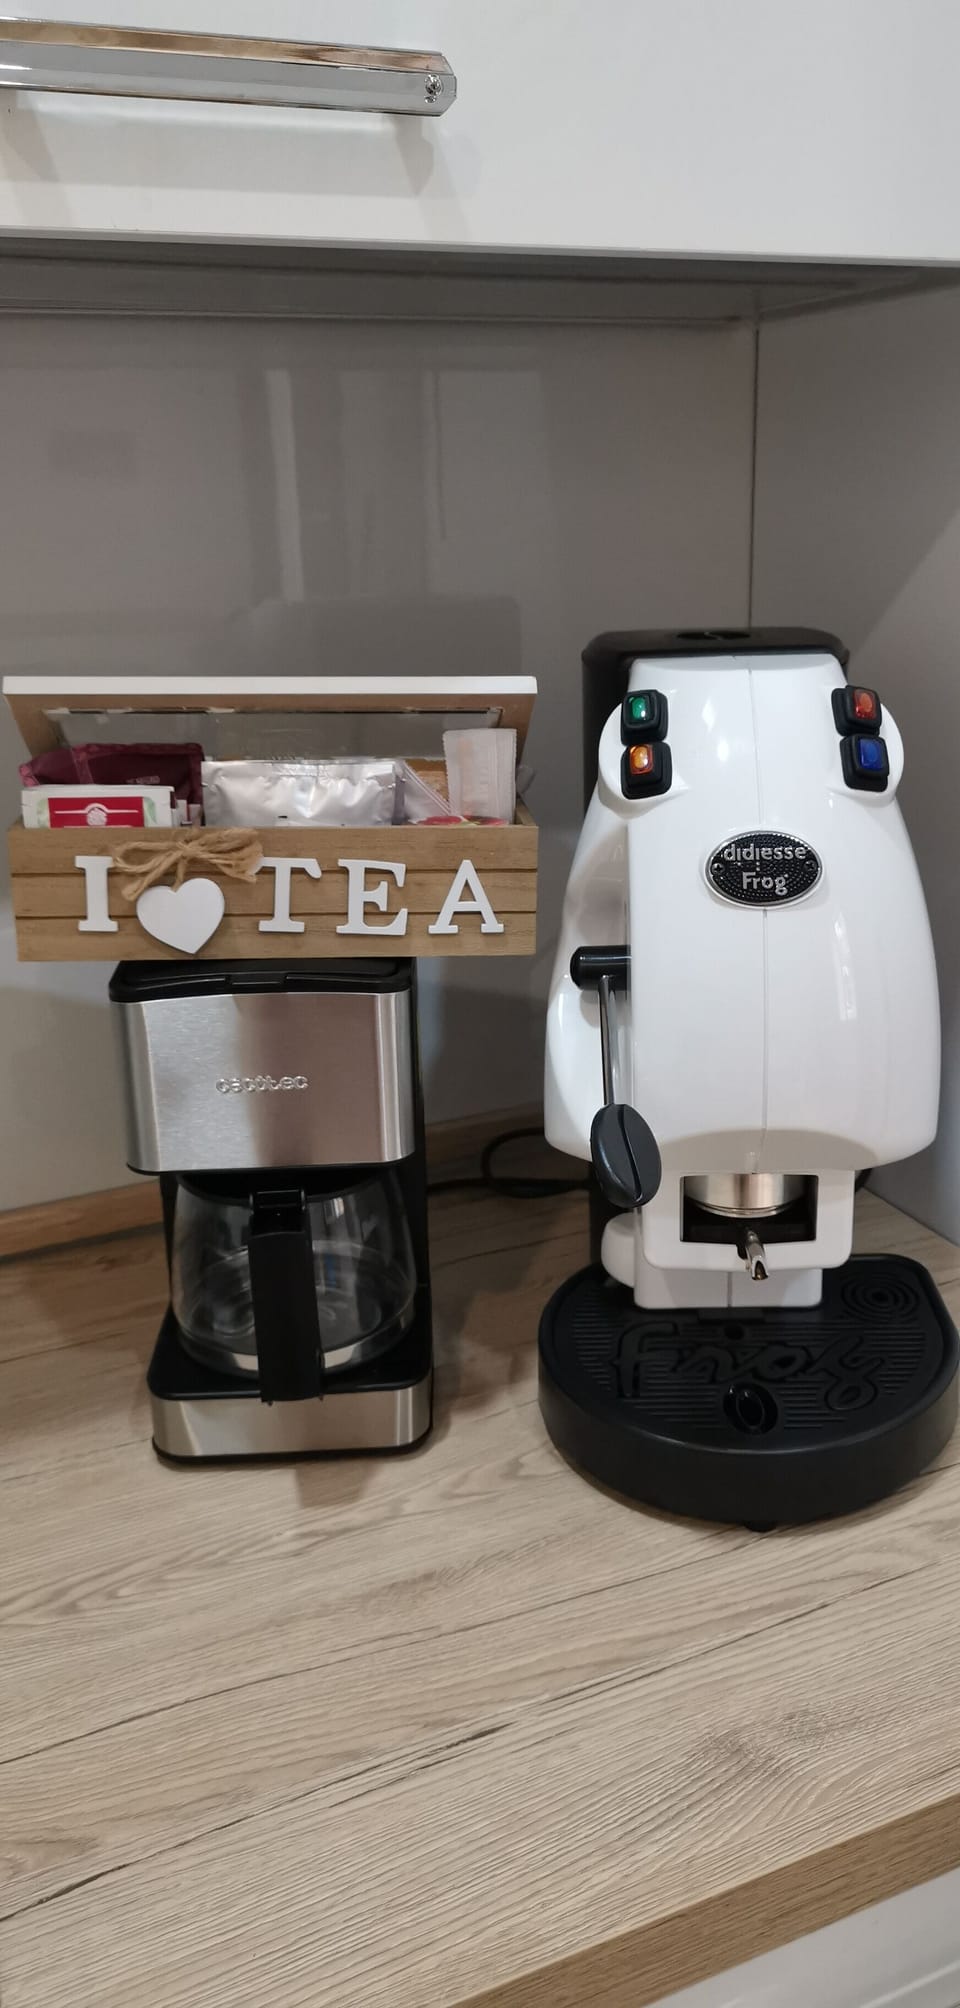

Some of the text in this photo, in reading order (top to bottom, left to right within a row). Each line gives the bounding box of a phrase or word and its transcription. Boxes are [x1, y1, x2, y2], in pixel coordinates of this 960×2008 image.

[723, 844, 807, 861] didiesse
[742, 872, 787, 895] Frog
[74, 855, 505, 936] I TEA
